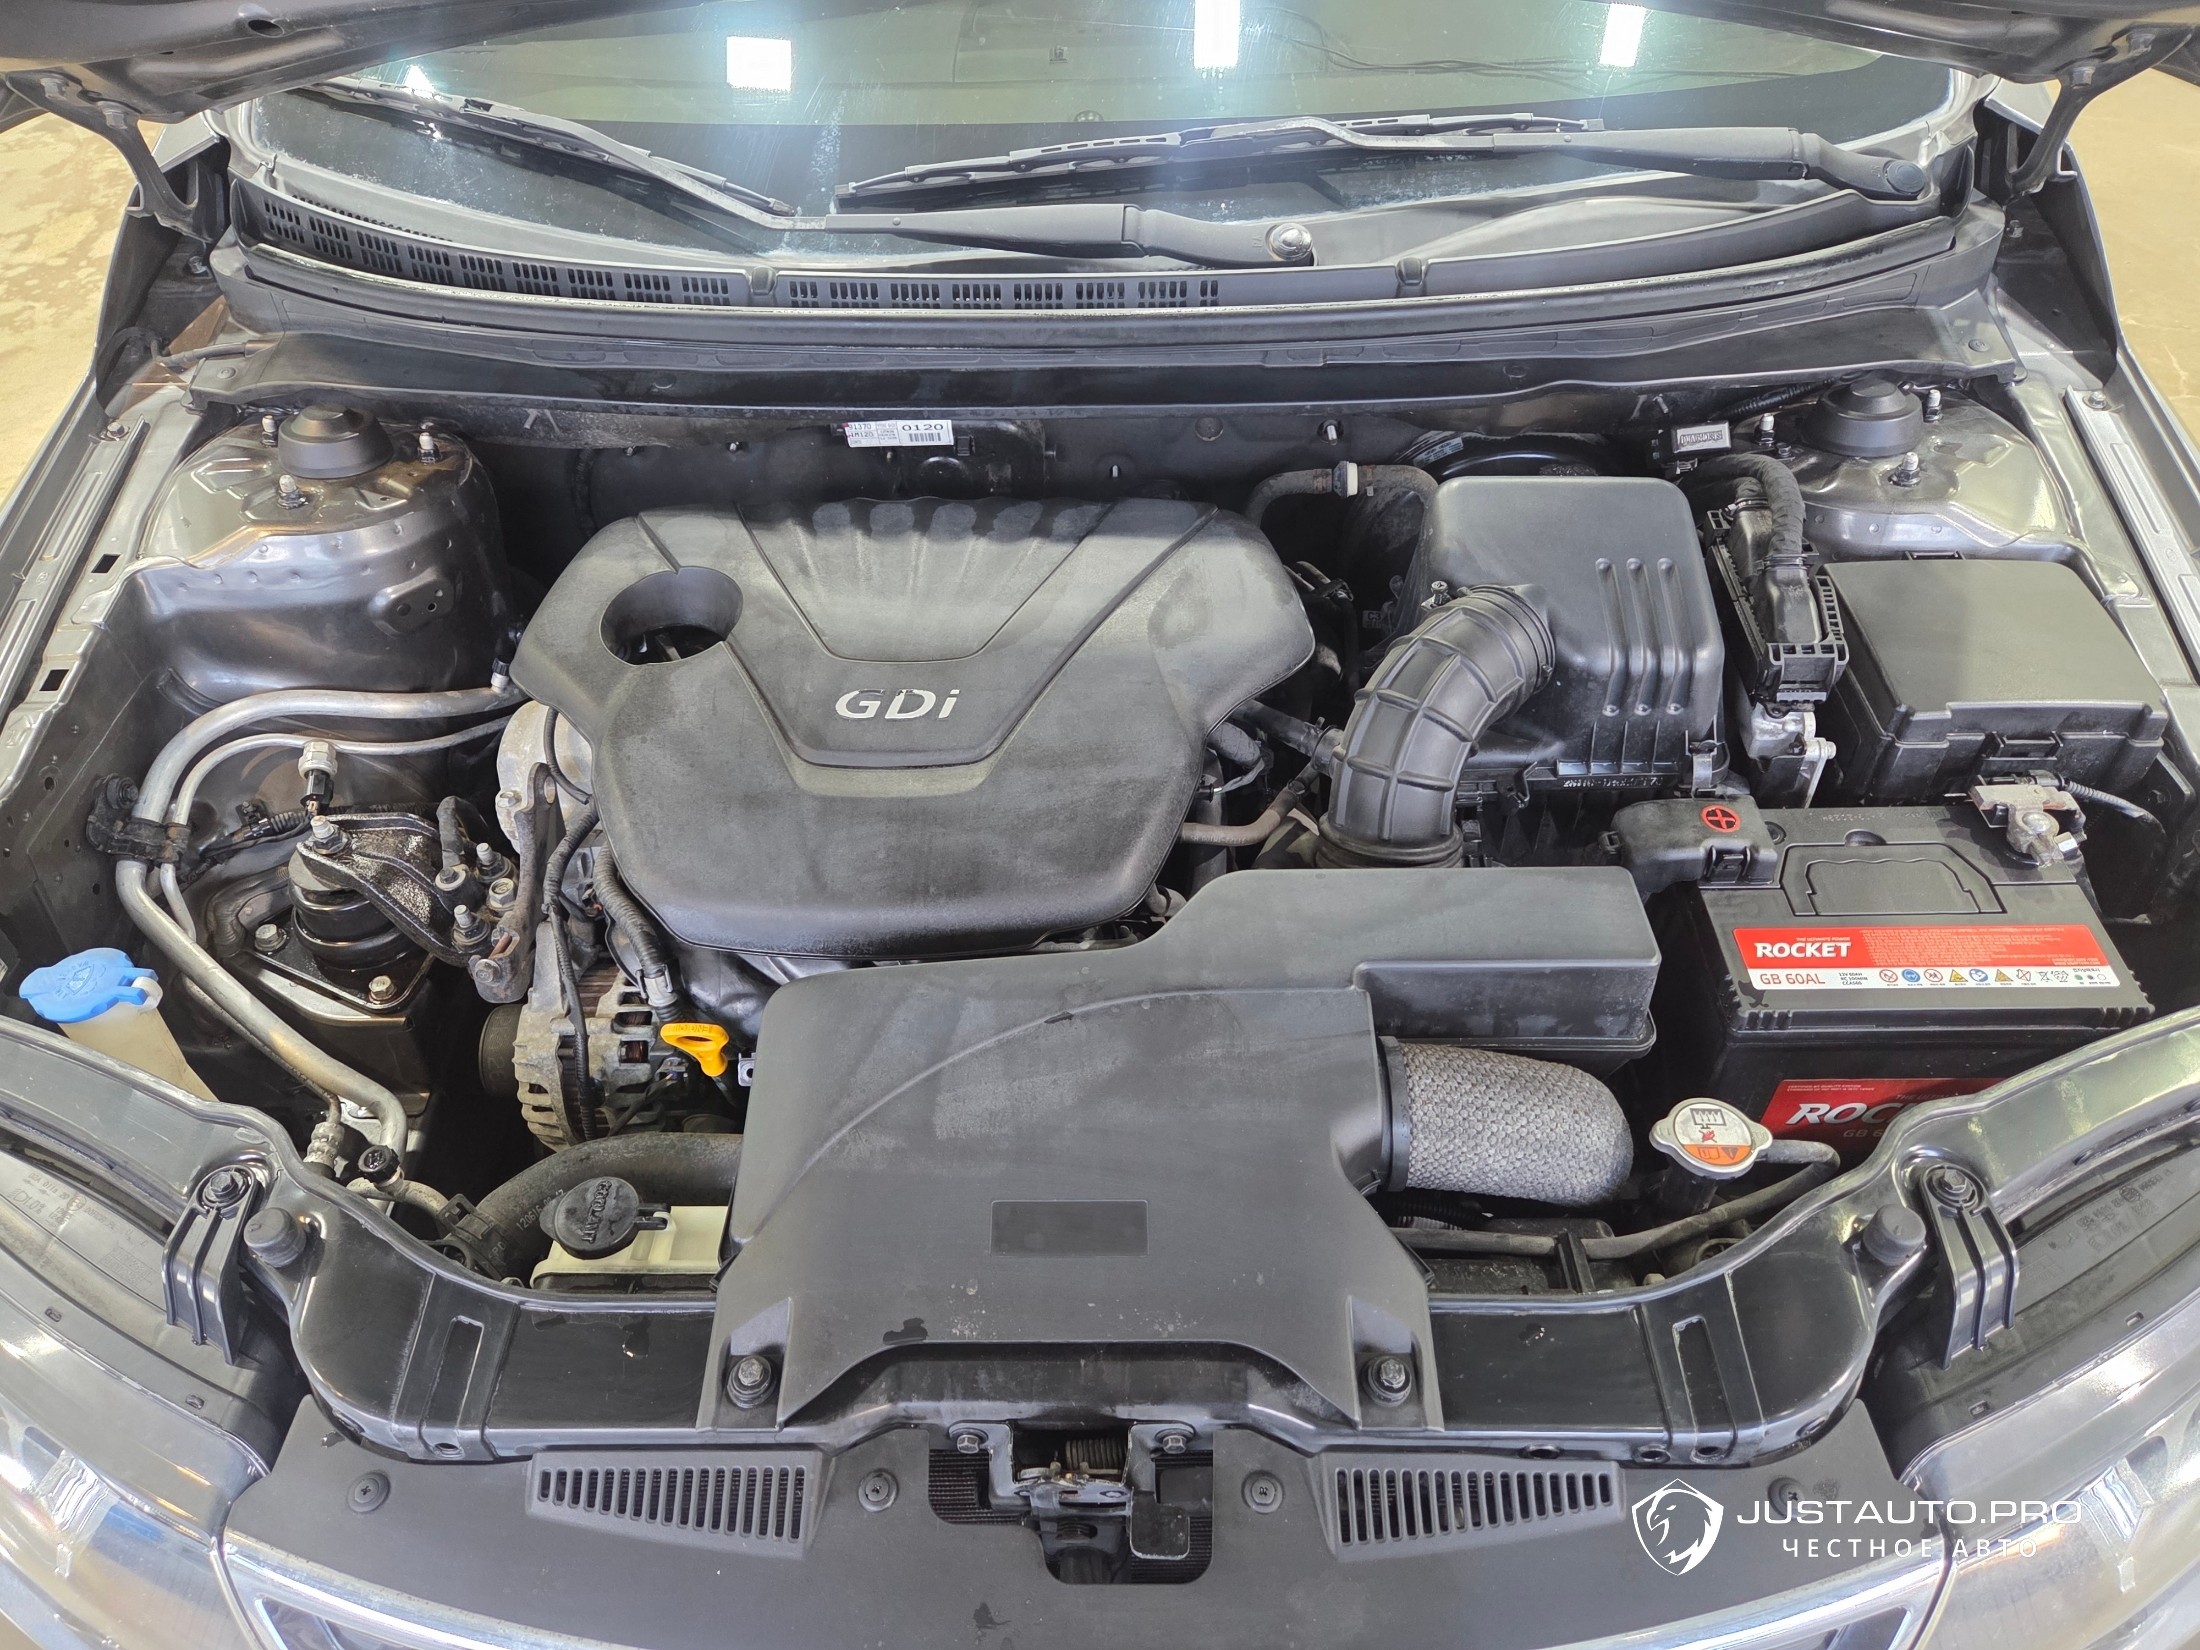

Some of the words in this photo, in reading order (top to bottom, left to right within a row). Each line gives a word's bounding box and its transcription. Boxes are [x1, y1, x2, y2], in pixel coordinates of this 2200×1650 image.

[902, 423, 944, 431] 0120
[835, 689, 961, 719] GDi
[1754, 942, 1852, 958] ROCKET
[1759, 973, 1782, 985] GB
[1785, 973, 1826, 985] 60AL
[1843, 1129, 1867, 1138] GB
